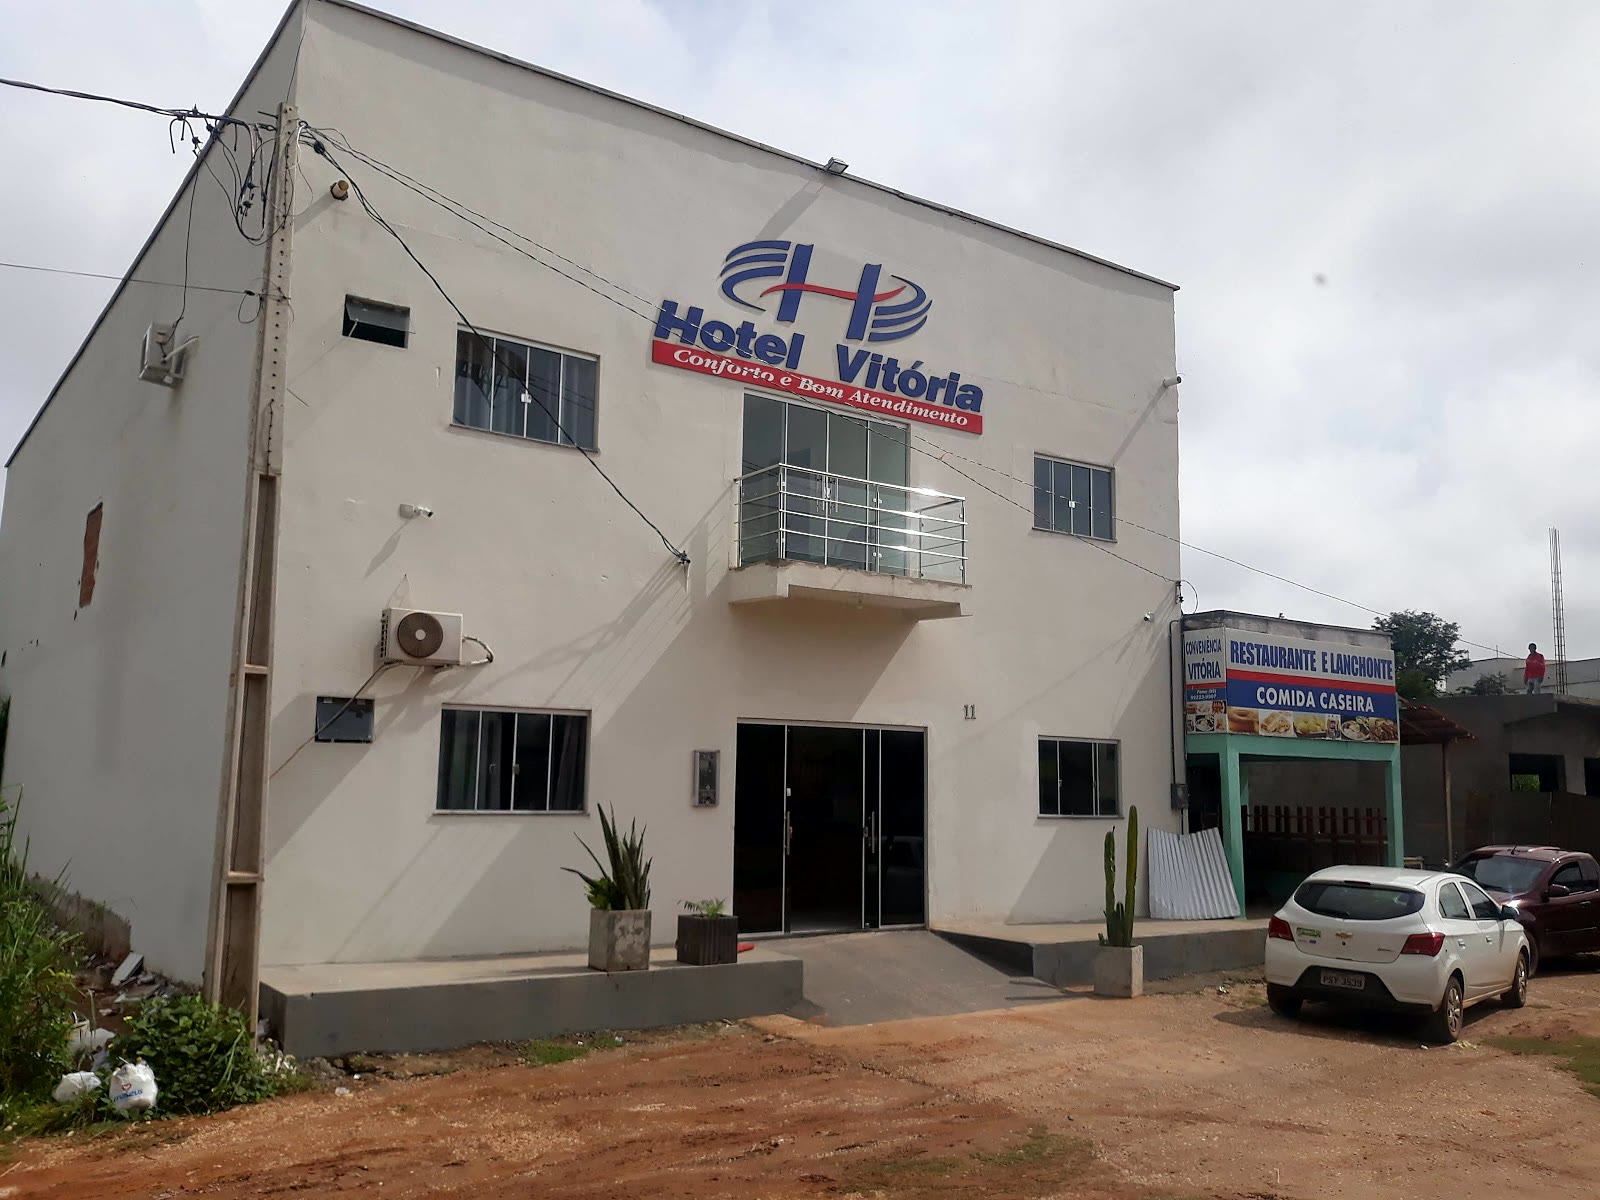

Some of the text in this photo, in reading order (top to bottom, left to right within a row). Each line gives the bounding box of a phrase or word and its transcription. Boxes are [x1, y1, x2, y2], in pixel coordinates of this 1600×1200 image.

[654, 299, 984, 413] Hotel Vitória
[673, 349, 968, 426] Conforto e Bom Atendimento
[1188, 657, 1221, 680] VITÓRIA
[1230, 640, 1393, 680] RESTAURANTE E LANCHONTE
[963, 704, 976, 720] 11
[1256, 686, 1375, 713] COMIDA CASEIRA
